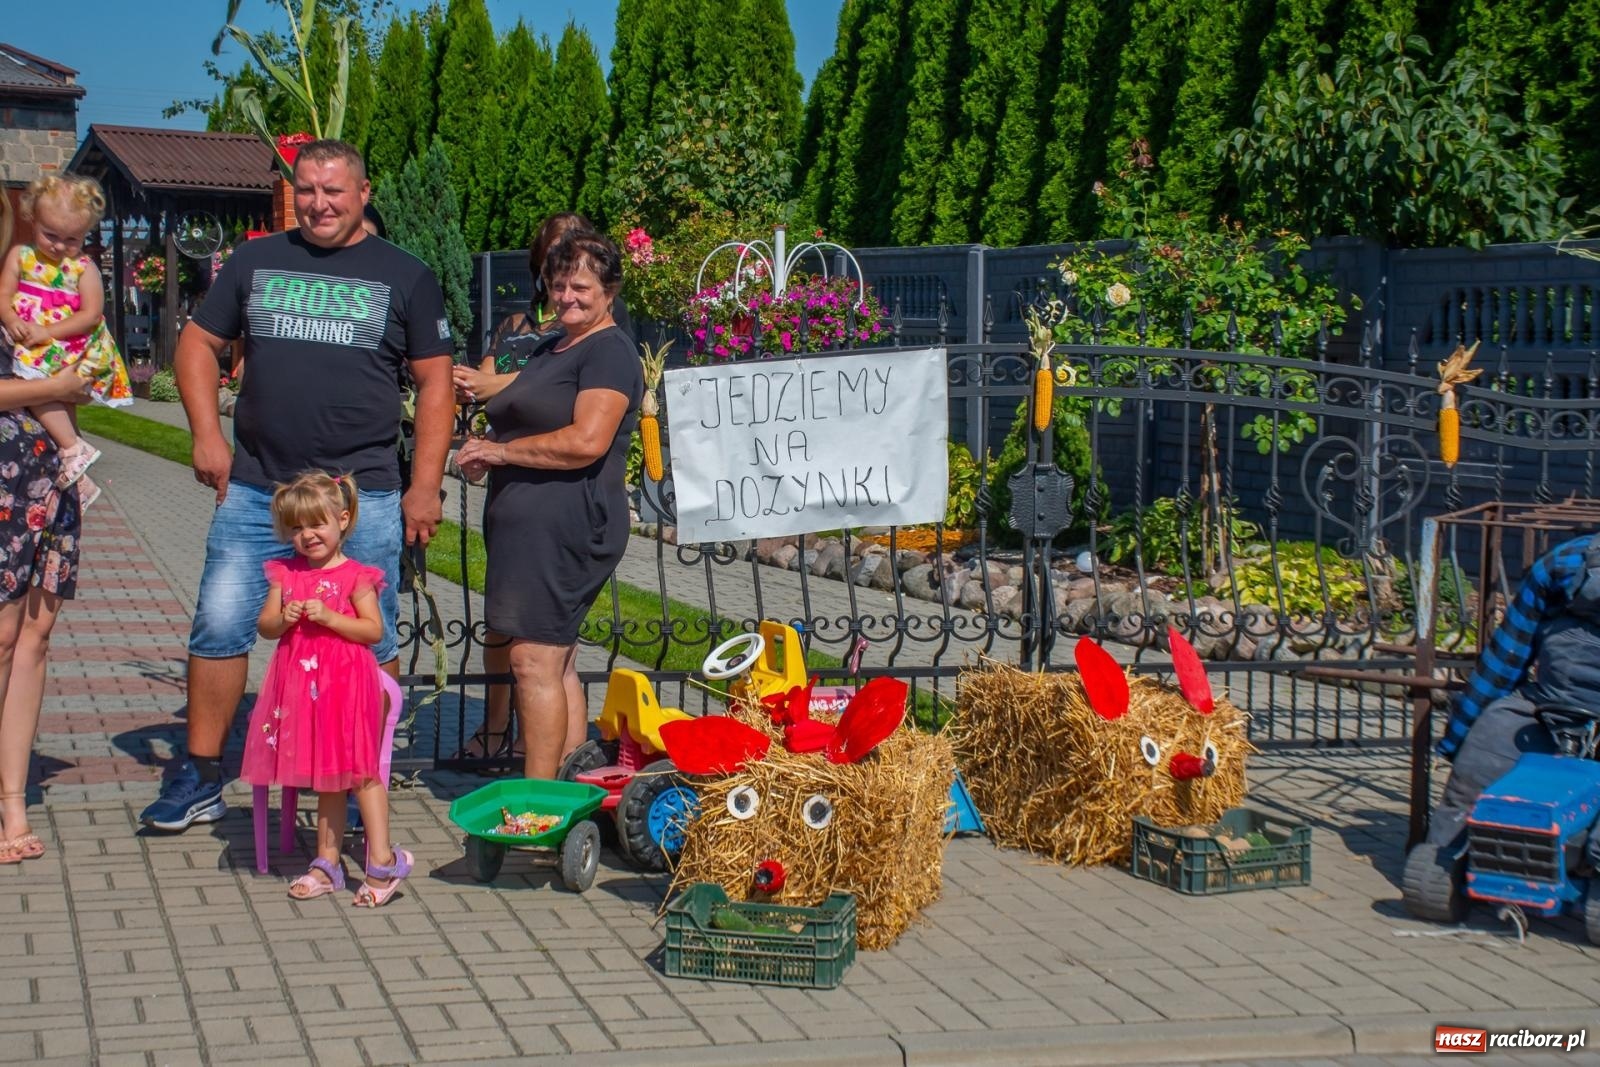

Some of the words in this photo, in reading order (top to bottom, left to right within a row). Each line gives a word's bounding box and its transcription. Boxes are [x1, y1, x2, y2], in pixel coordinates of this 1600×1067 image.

[262, 276, 371, 319] CROSS
[272, 314, 354, 344] TRAINING
[699, 366, 892, 429] JEDZIEMY
[750, 430, 811, 466] NA
[704, 465, 893, 527] DOZYNKI
